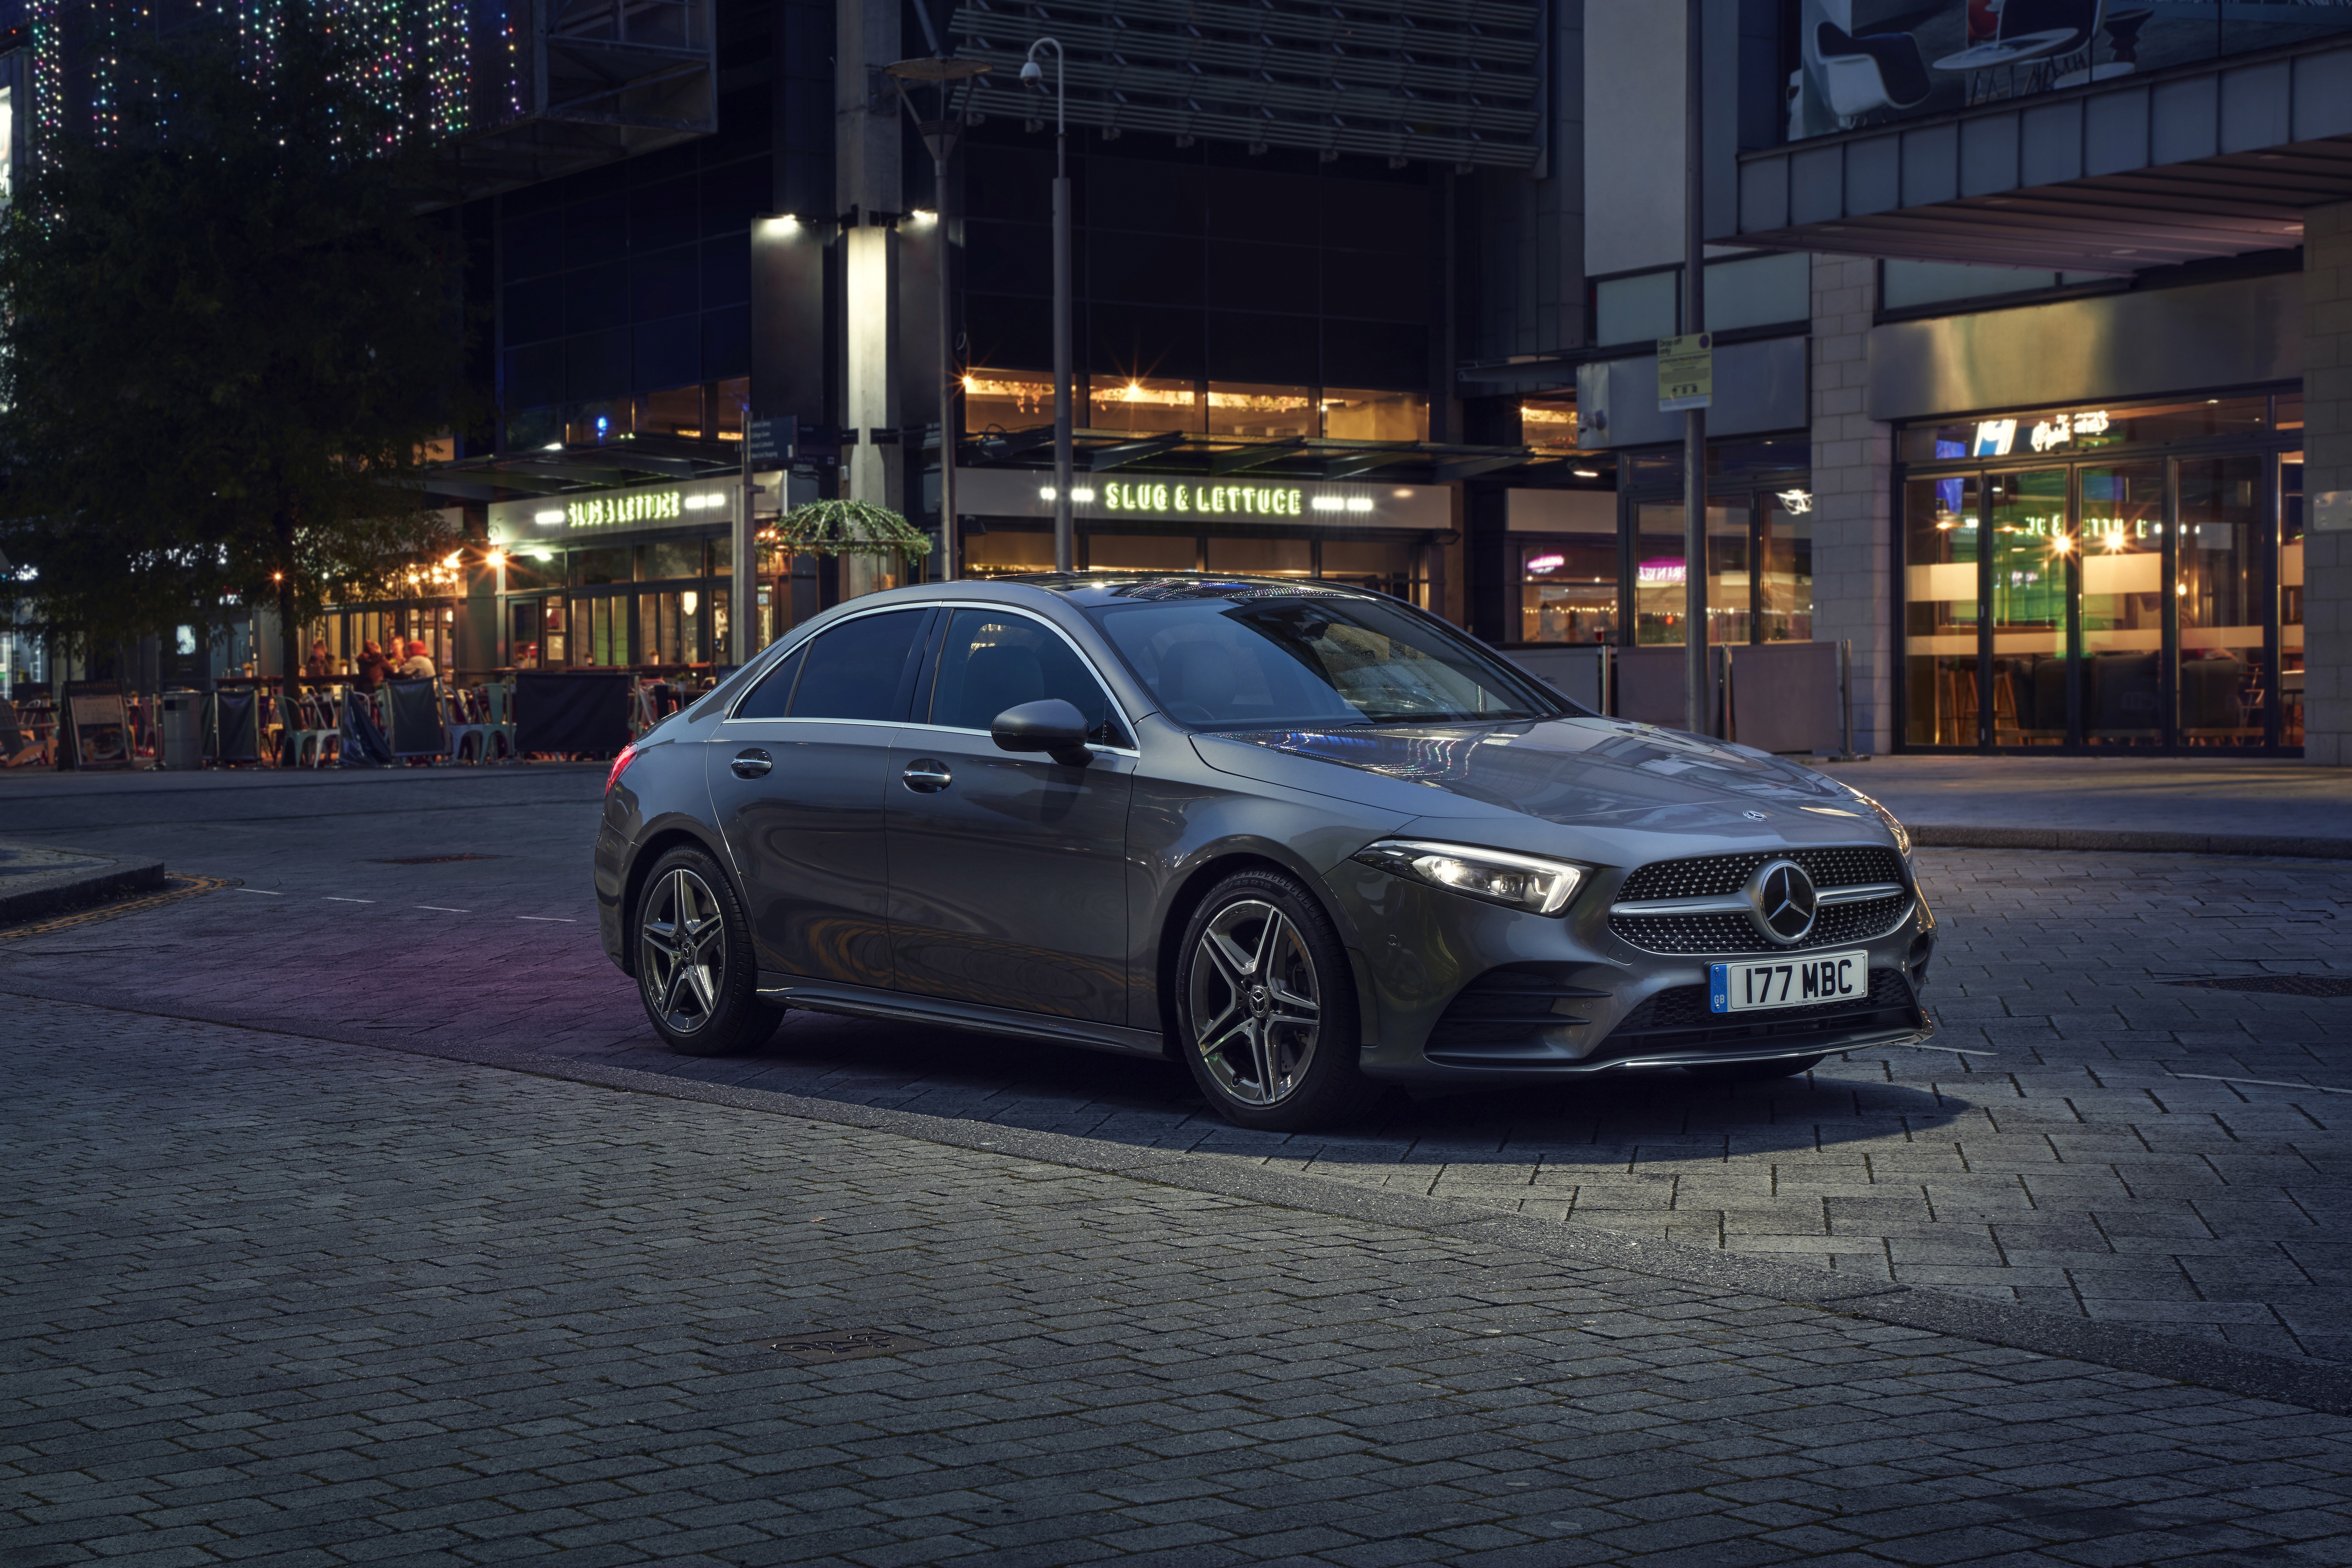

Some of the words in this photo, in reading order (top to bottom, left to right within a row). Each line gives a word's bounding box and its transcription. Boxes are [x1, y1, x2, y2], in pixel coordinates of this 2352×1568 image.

[1105, 482, 1168, 510] SLUG
[1175, 485, 1189, 510] &
[1196, 486, 1301, 515] LETTUCE
[1250, 879, 1272, 889] R18
[1746, 965, 1793, 1004] 177
[1802, 959, 1853, 999] MBC
[1714, 994, 1725, 1004] GB
